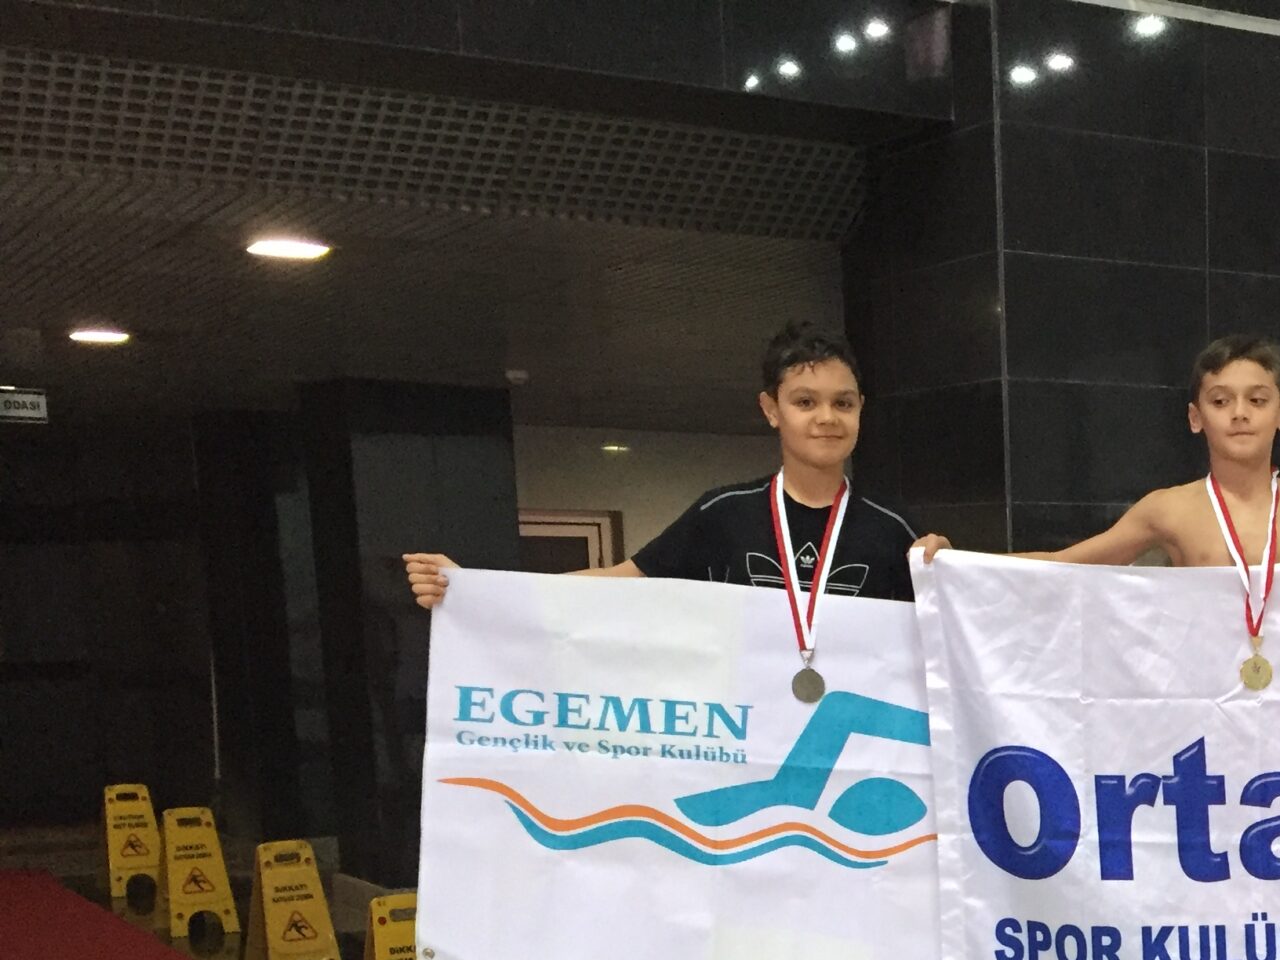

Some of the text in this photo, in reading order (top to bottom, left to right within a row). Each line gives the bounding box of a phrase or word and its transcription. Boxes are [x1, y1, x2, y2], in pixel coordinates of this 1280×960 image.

[453, 684, 754, 741] EGEMEN
[456, 729, 748, 765] Gençlik ve Spor Kulübü
